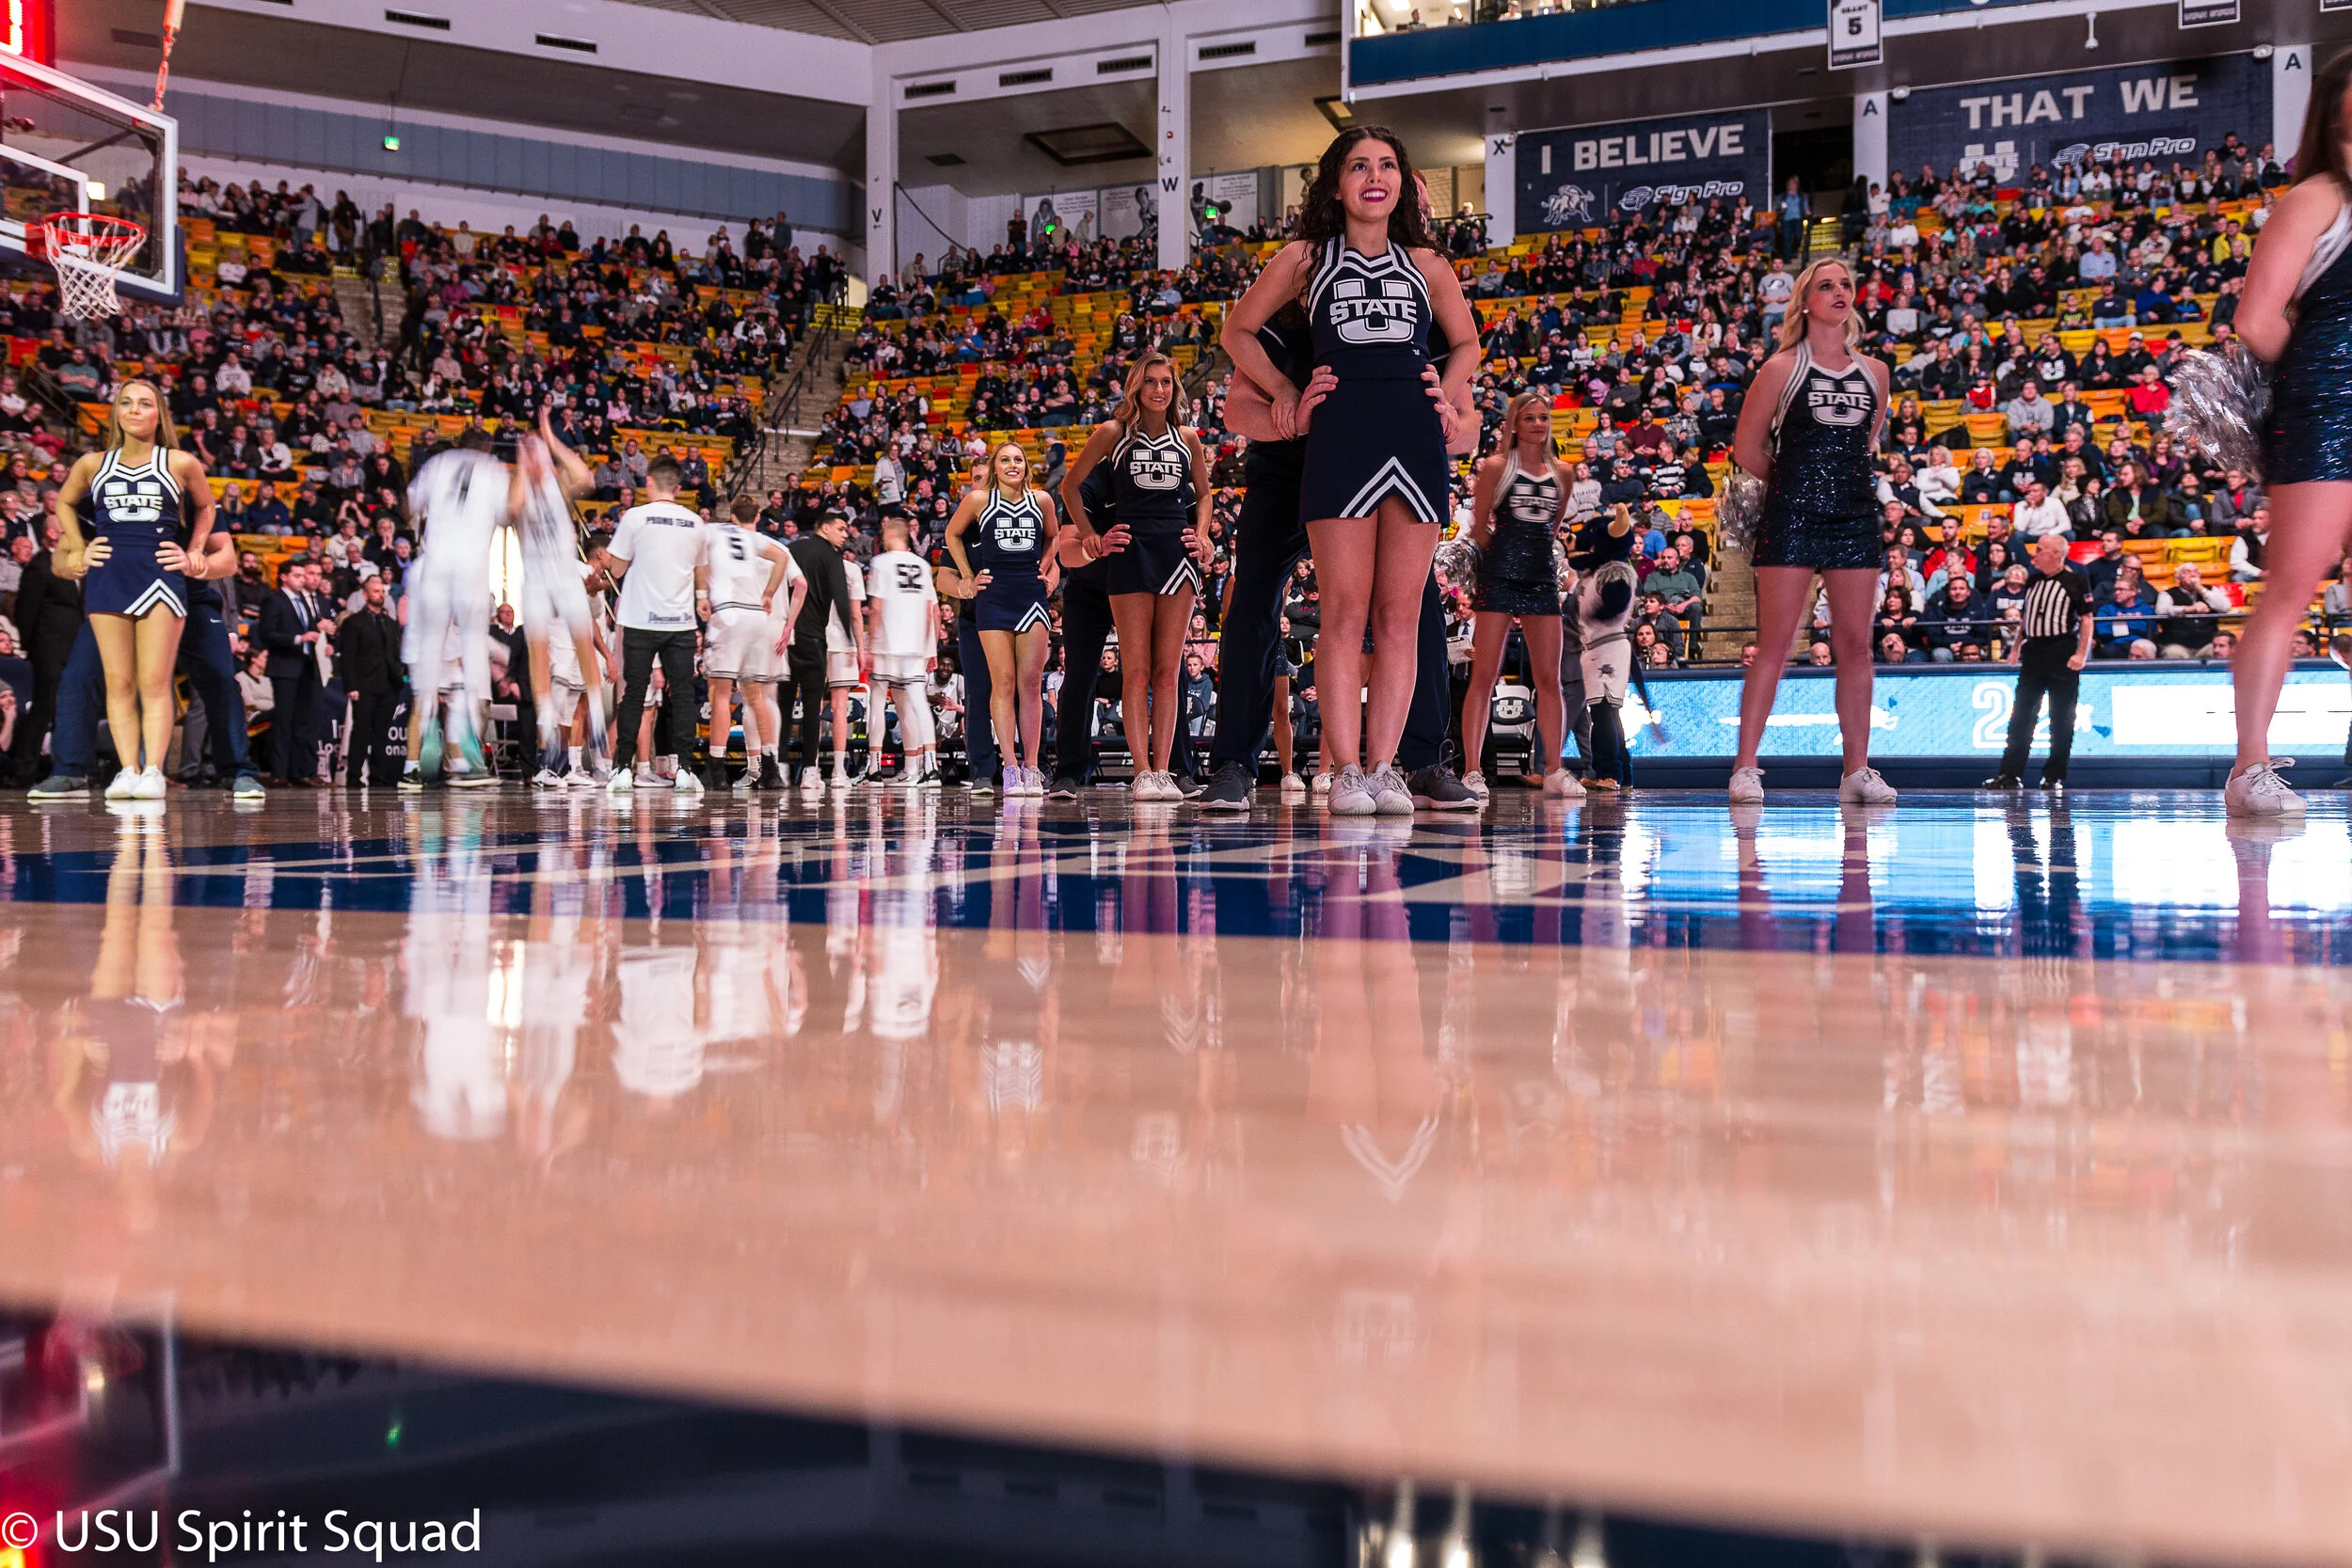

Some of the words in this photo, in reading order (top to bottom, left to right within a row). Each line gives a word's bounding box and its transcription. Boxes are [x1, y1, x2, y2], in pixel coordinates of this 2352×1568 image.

[1848, 17, 1862, 35] 5
[2284, 53, 2302, 71] A
[1863, 99, 1879, 117] A
[1959, 85, 2095, 130] THAT
[2119, 73, 2200, 114] WE
[1493, 138, 1506, 155] X
[1541, 145, 1551, 175] I
[1573, 123, 1745, 171] BELIEVE
[1162, 176, 1179, 193] W
[1329, 298, 1418, 325] STATE
[1807, 391, 1871, 411] STATE
[1129, 461, 1183, 478] STATE
[103, 494, 164, 510] STATE
[993, 528, 1036, 540] STATE
[897, 563, 923, 590] 52
